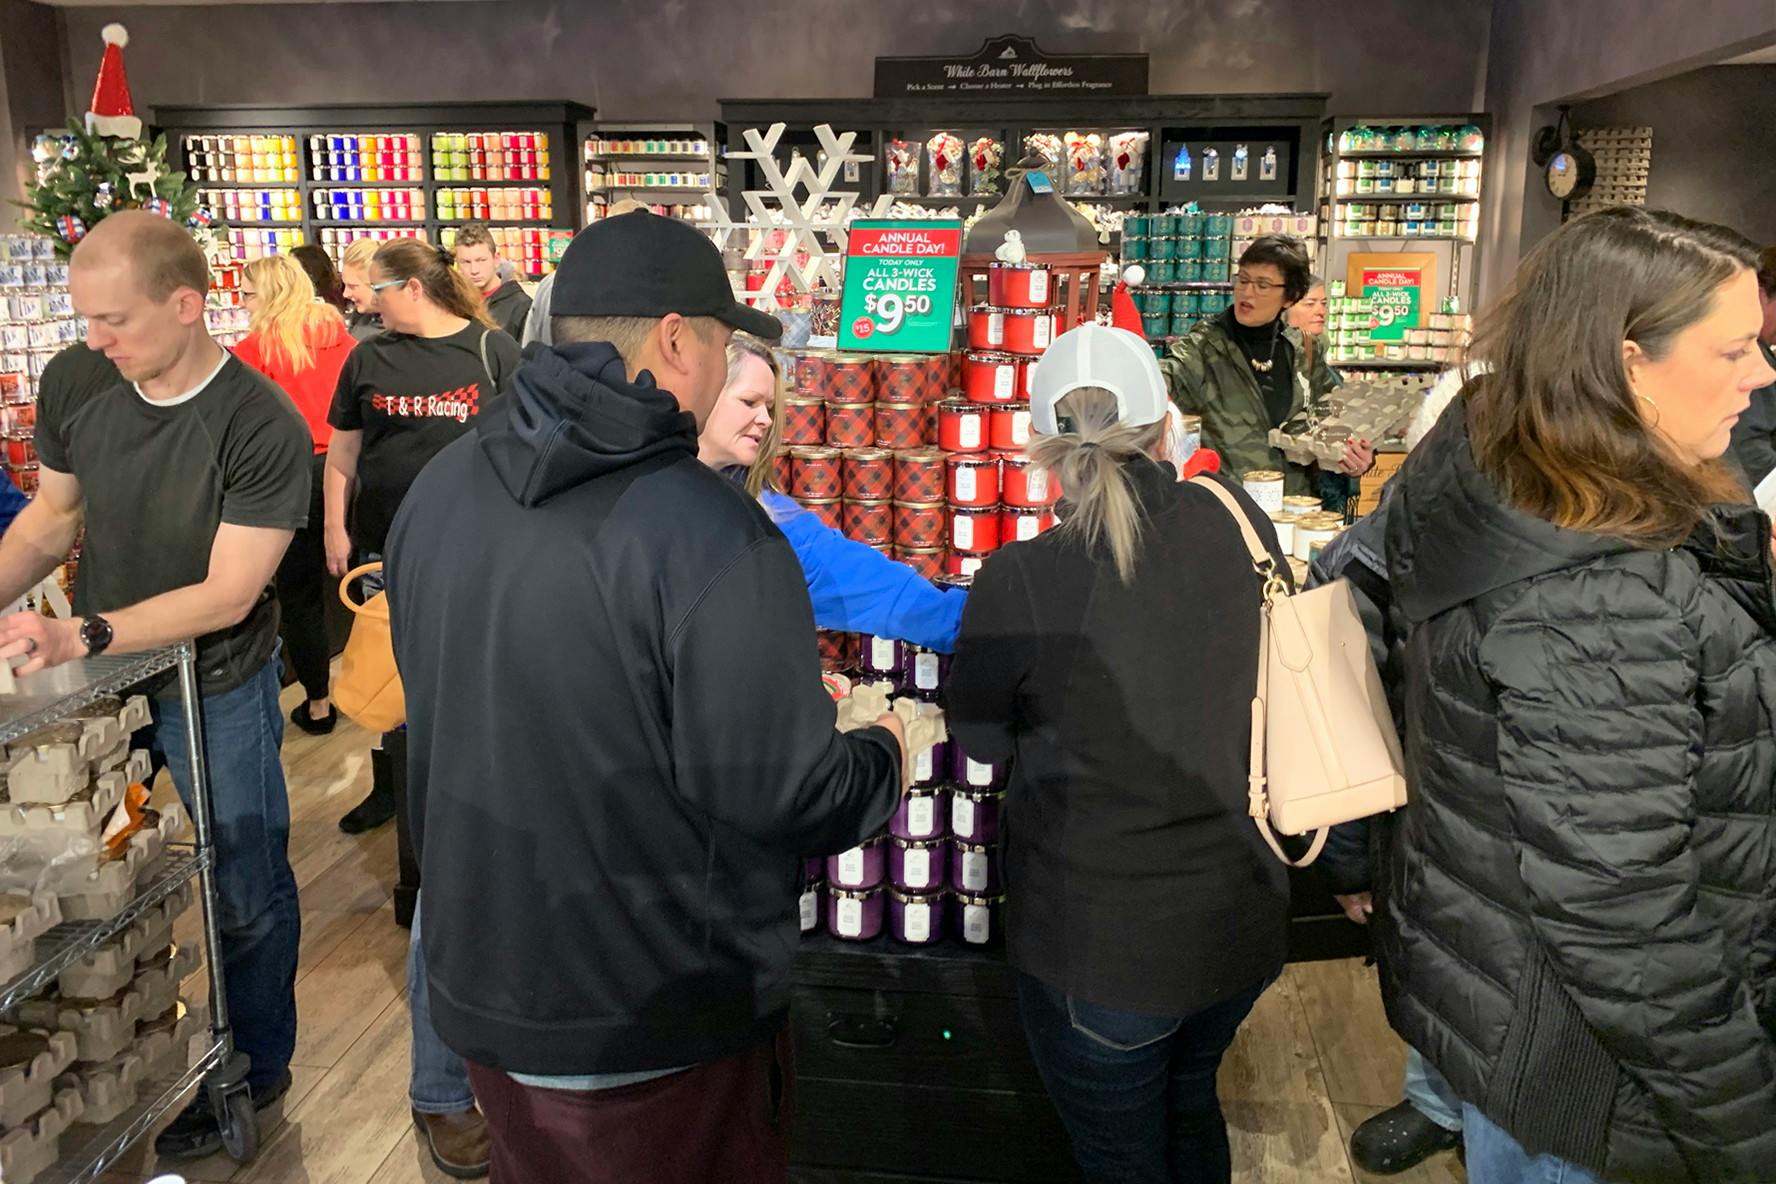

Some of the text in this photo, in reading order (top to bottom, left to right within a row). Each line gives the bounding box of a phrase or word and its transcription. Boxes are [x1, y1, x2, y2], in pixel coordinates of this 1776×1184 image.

[943, 63, 1074, 81] White Barn Wallflowers
[906, 83, 921, 91] Pick
[878, 232, 932, 243] ANNUAL
[862, 243, 945, 254] CANDLE DAY!
[867, 267, 935, 277] ALL 3-WICK
[862, 278, 937, 292] CANDLES
[1371, 297, 1412, 305] CANDLES
[385, 395, 468, 423] T & R Racing
